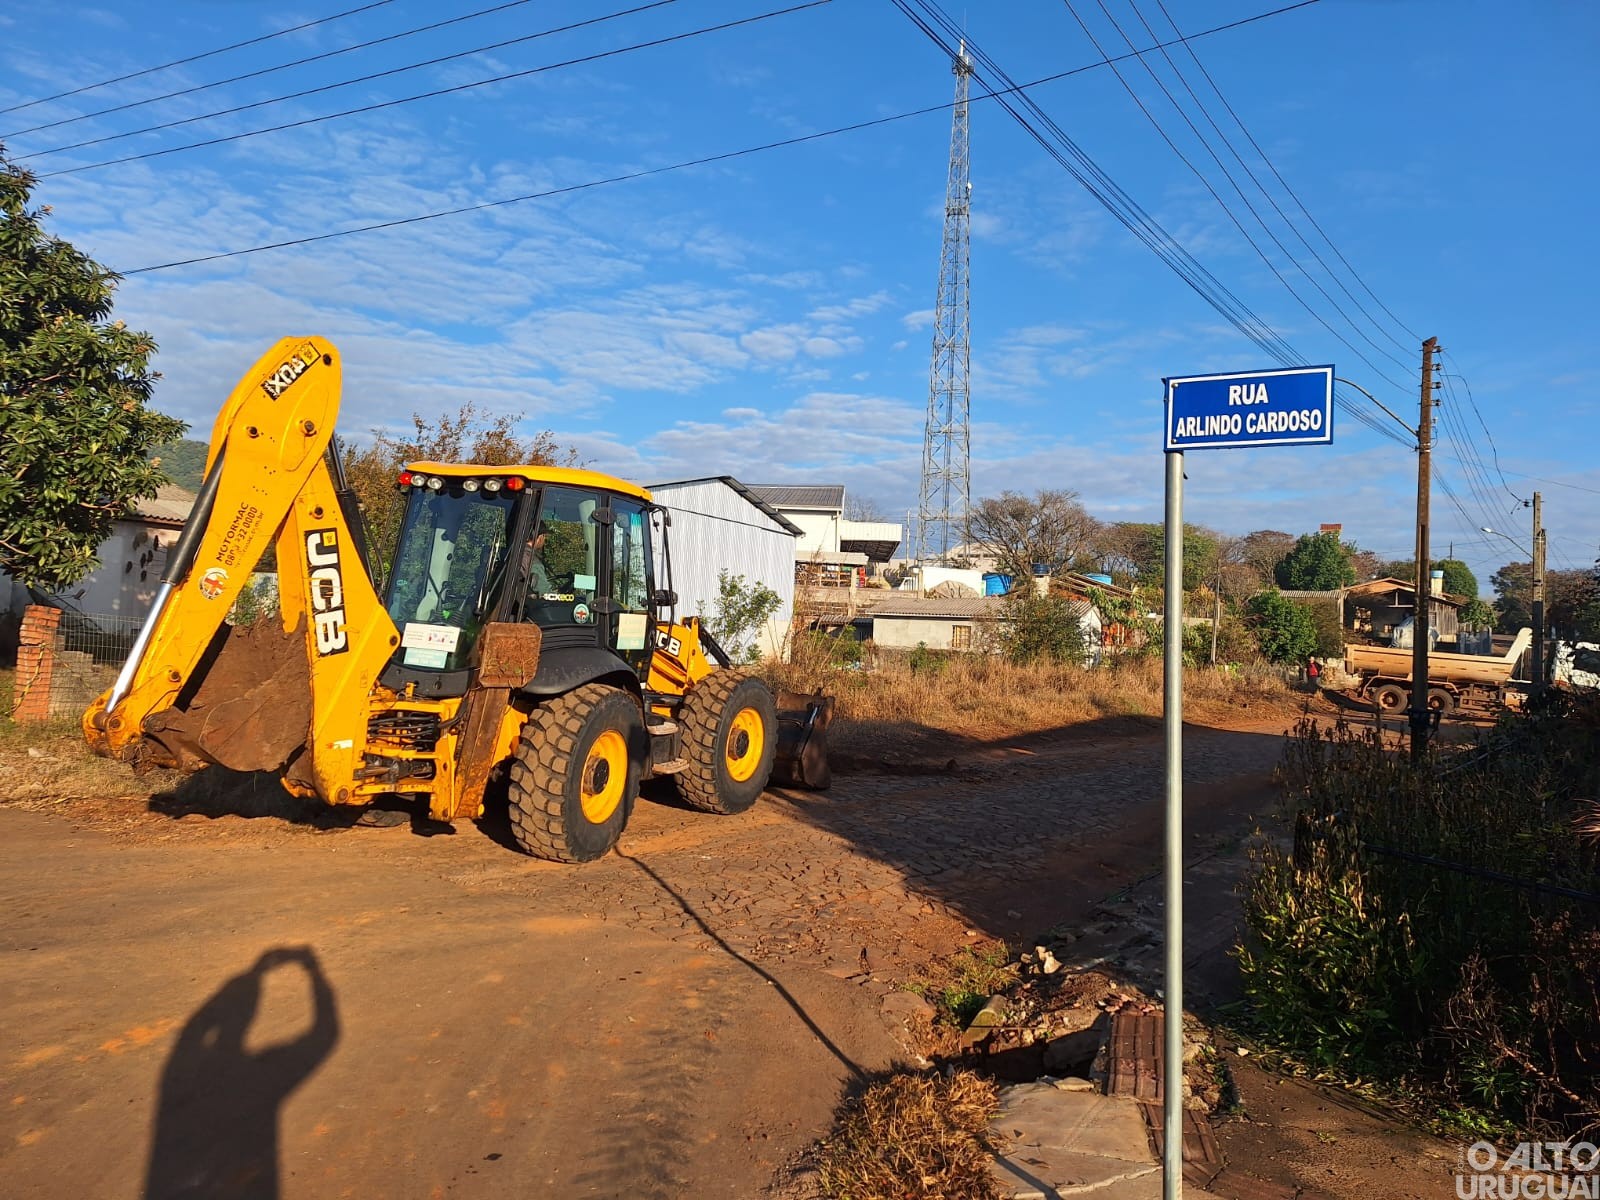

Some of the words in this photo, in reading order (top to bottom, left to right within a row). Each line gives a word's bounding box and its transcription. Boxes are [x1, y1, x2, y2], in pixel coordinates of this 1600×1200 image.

[1228, 383, 1269, 406] RUA
[1175, 413, 1242, 438] ARLINDO
[1246, 409, 1322, 434] CARDOSO
[216, 502, 249, 562] MOTORMAC
[242, 506, 258, 529] 0000
[307, 532, 346, 654] JCB
